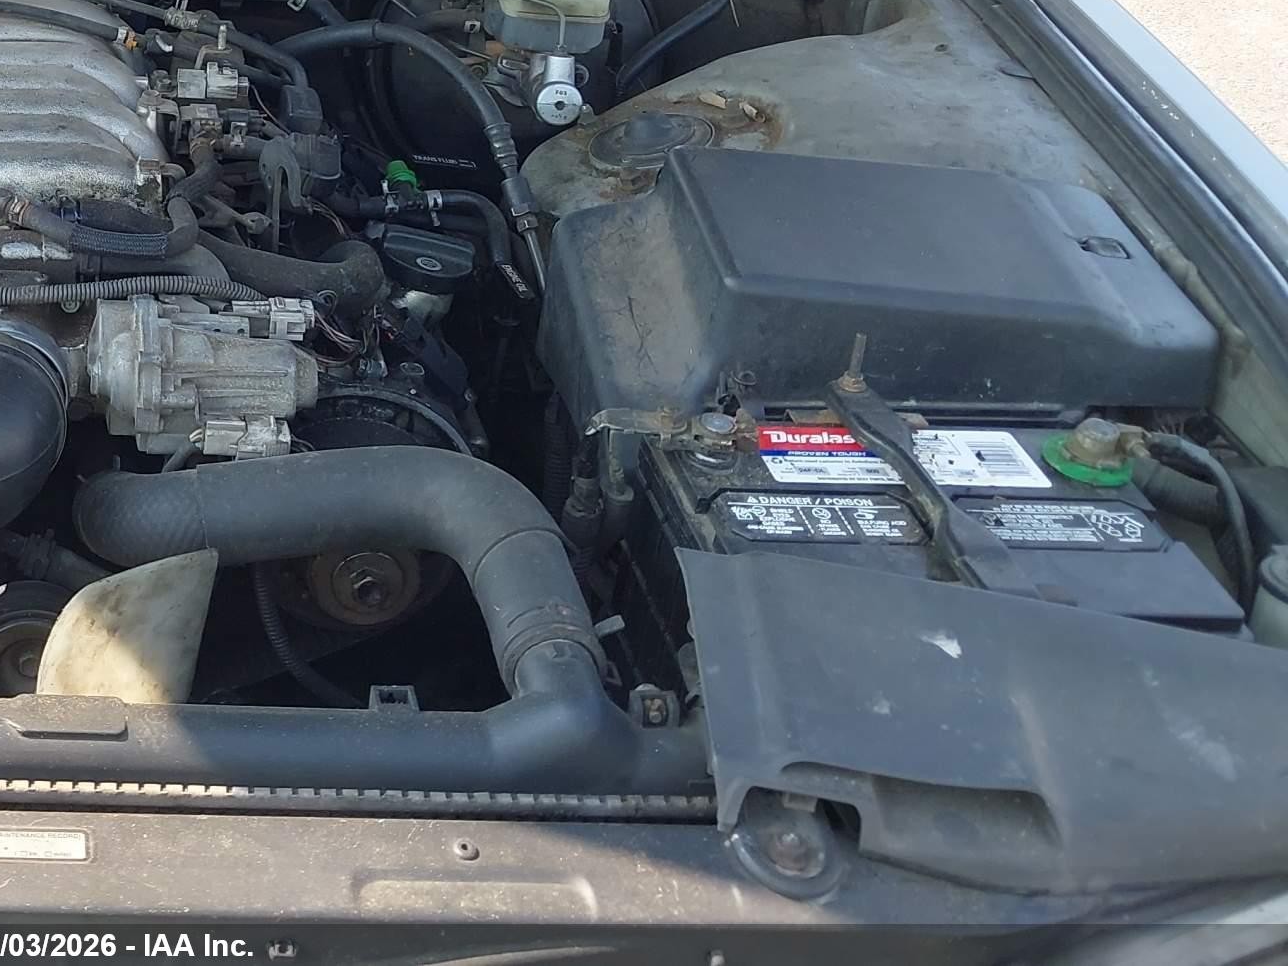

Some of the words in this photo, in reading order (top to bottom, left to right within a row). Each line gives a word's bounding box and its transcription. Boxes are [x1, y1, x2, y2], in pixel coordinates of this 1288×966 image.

[762, 430, 857, 445] Duralas
[758, 496, 812, 505] DANGER
[823, 497, 873, 507] POISON
